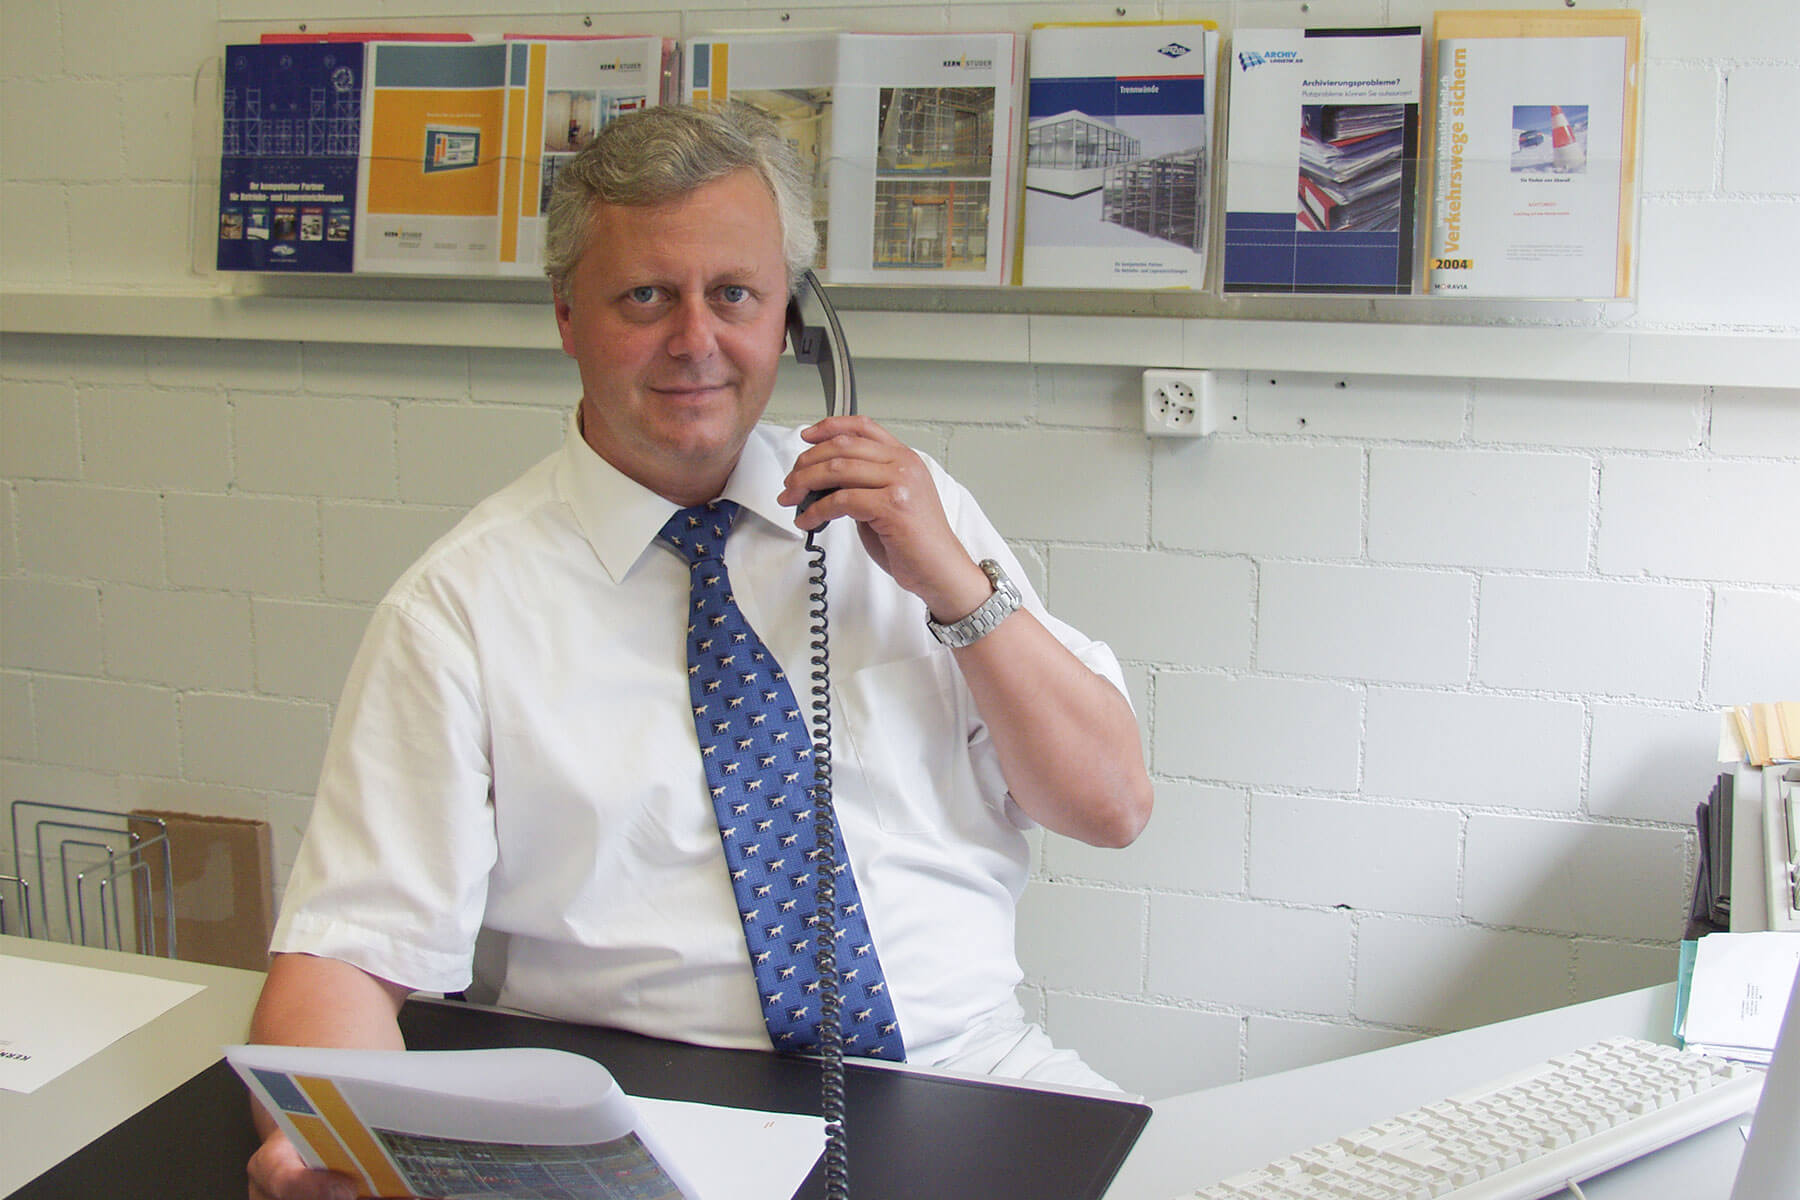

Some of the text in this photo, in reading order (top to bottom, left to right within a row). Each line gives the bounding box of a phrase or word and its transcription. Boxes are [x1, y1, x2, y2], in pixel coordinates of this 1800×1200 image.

[966, 59, 992, 67] STUDER
[1302, 79, 1400, 89] Archivierungsprobleme?
[1119, 85, 1160, 94] Trennwände
[1368, 89, 1378, 97] Sie
[1443, 47, 1469, 254] Verkehrswege sichern
[1435, 260, 1469, 270] 2004
